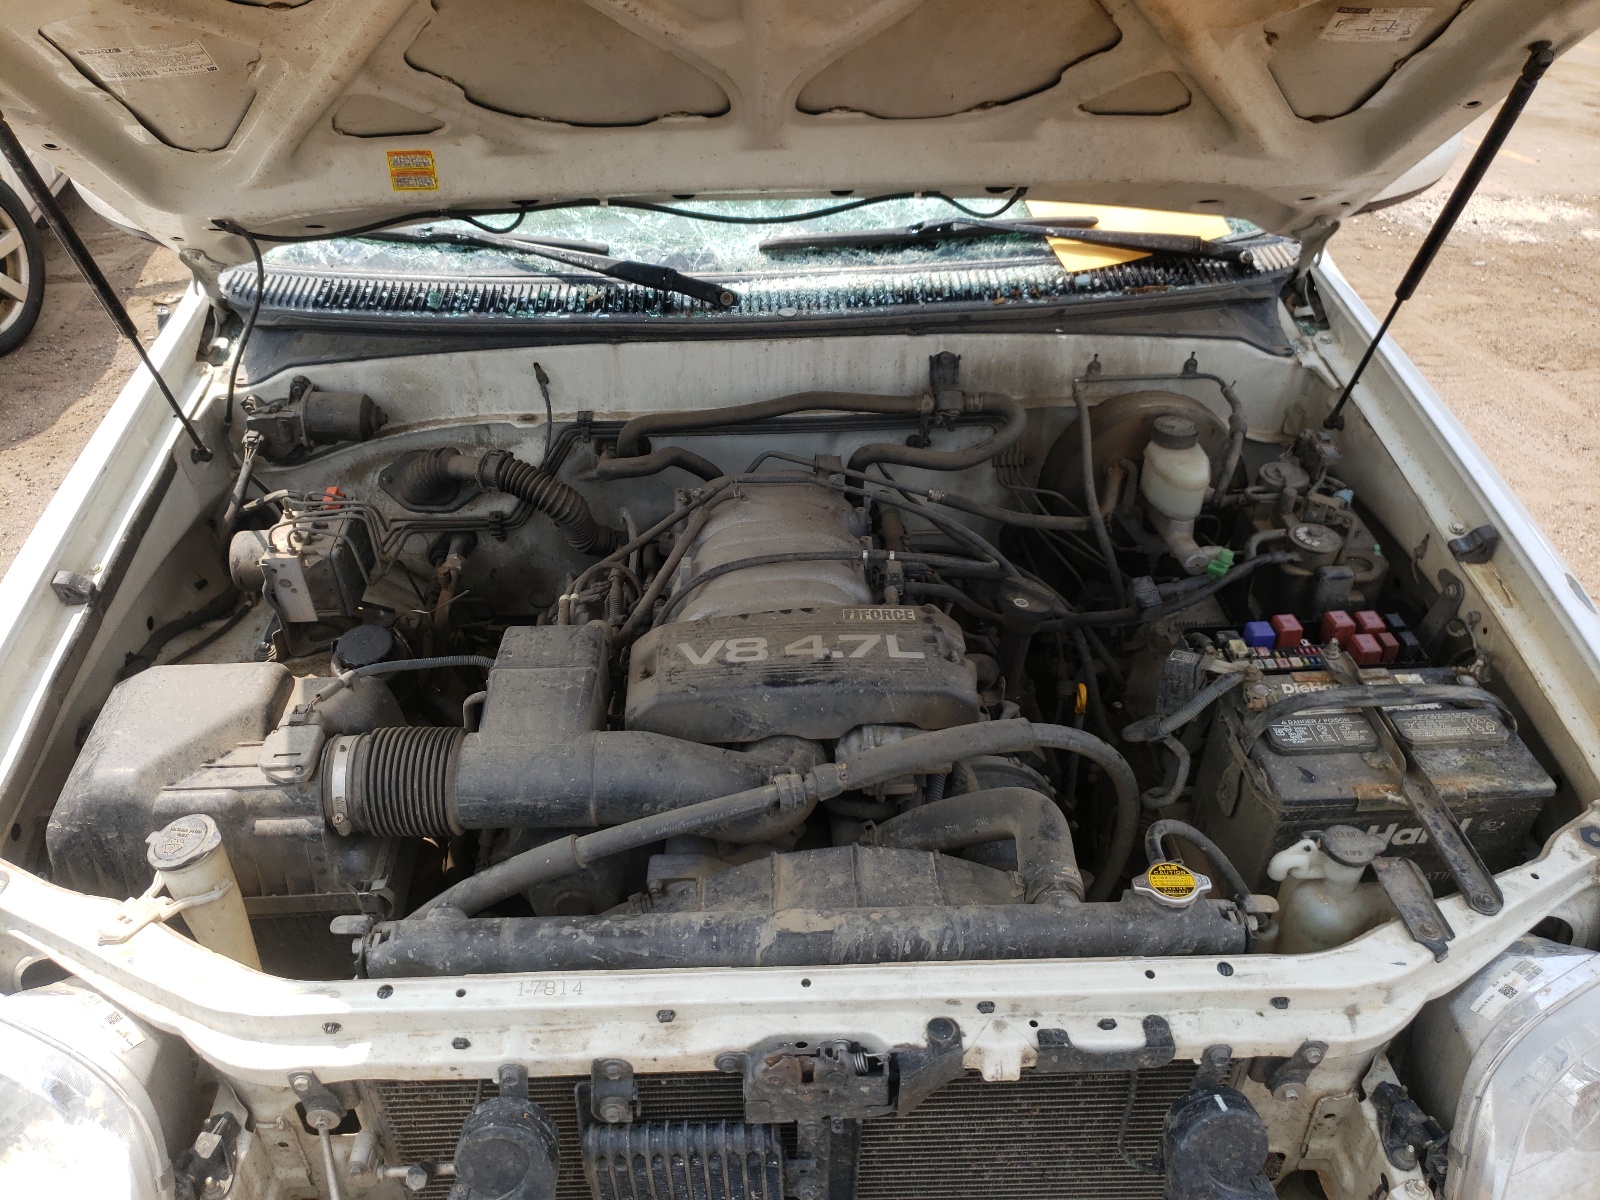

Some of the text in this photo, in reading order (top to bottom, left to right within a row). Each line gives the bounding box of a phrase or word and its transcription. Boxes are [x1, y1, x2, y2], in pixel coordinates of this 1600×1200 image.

[677, 633, 925, 666] V8 4.7L
[1281, 682, 1341, 694] DieHar
